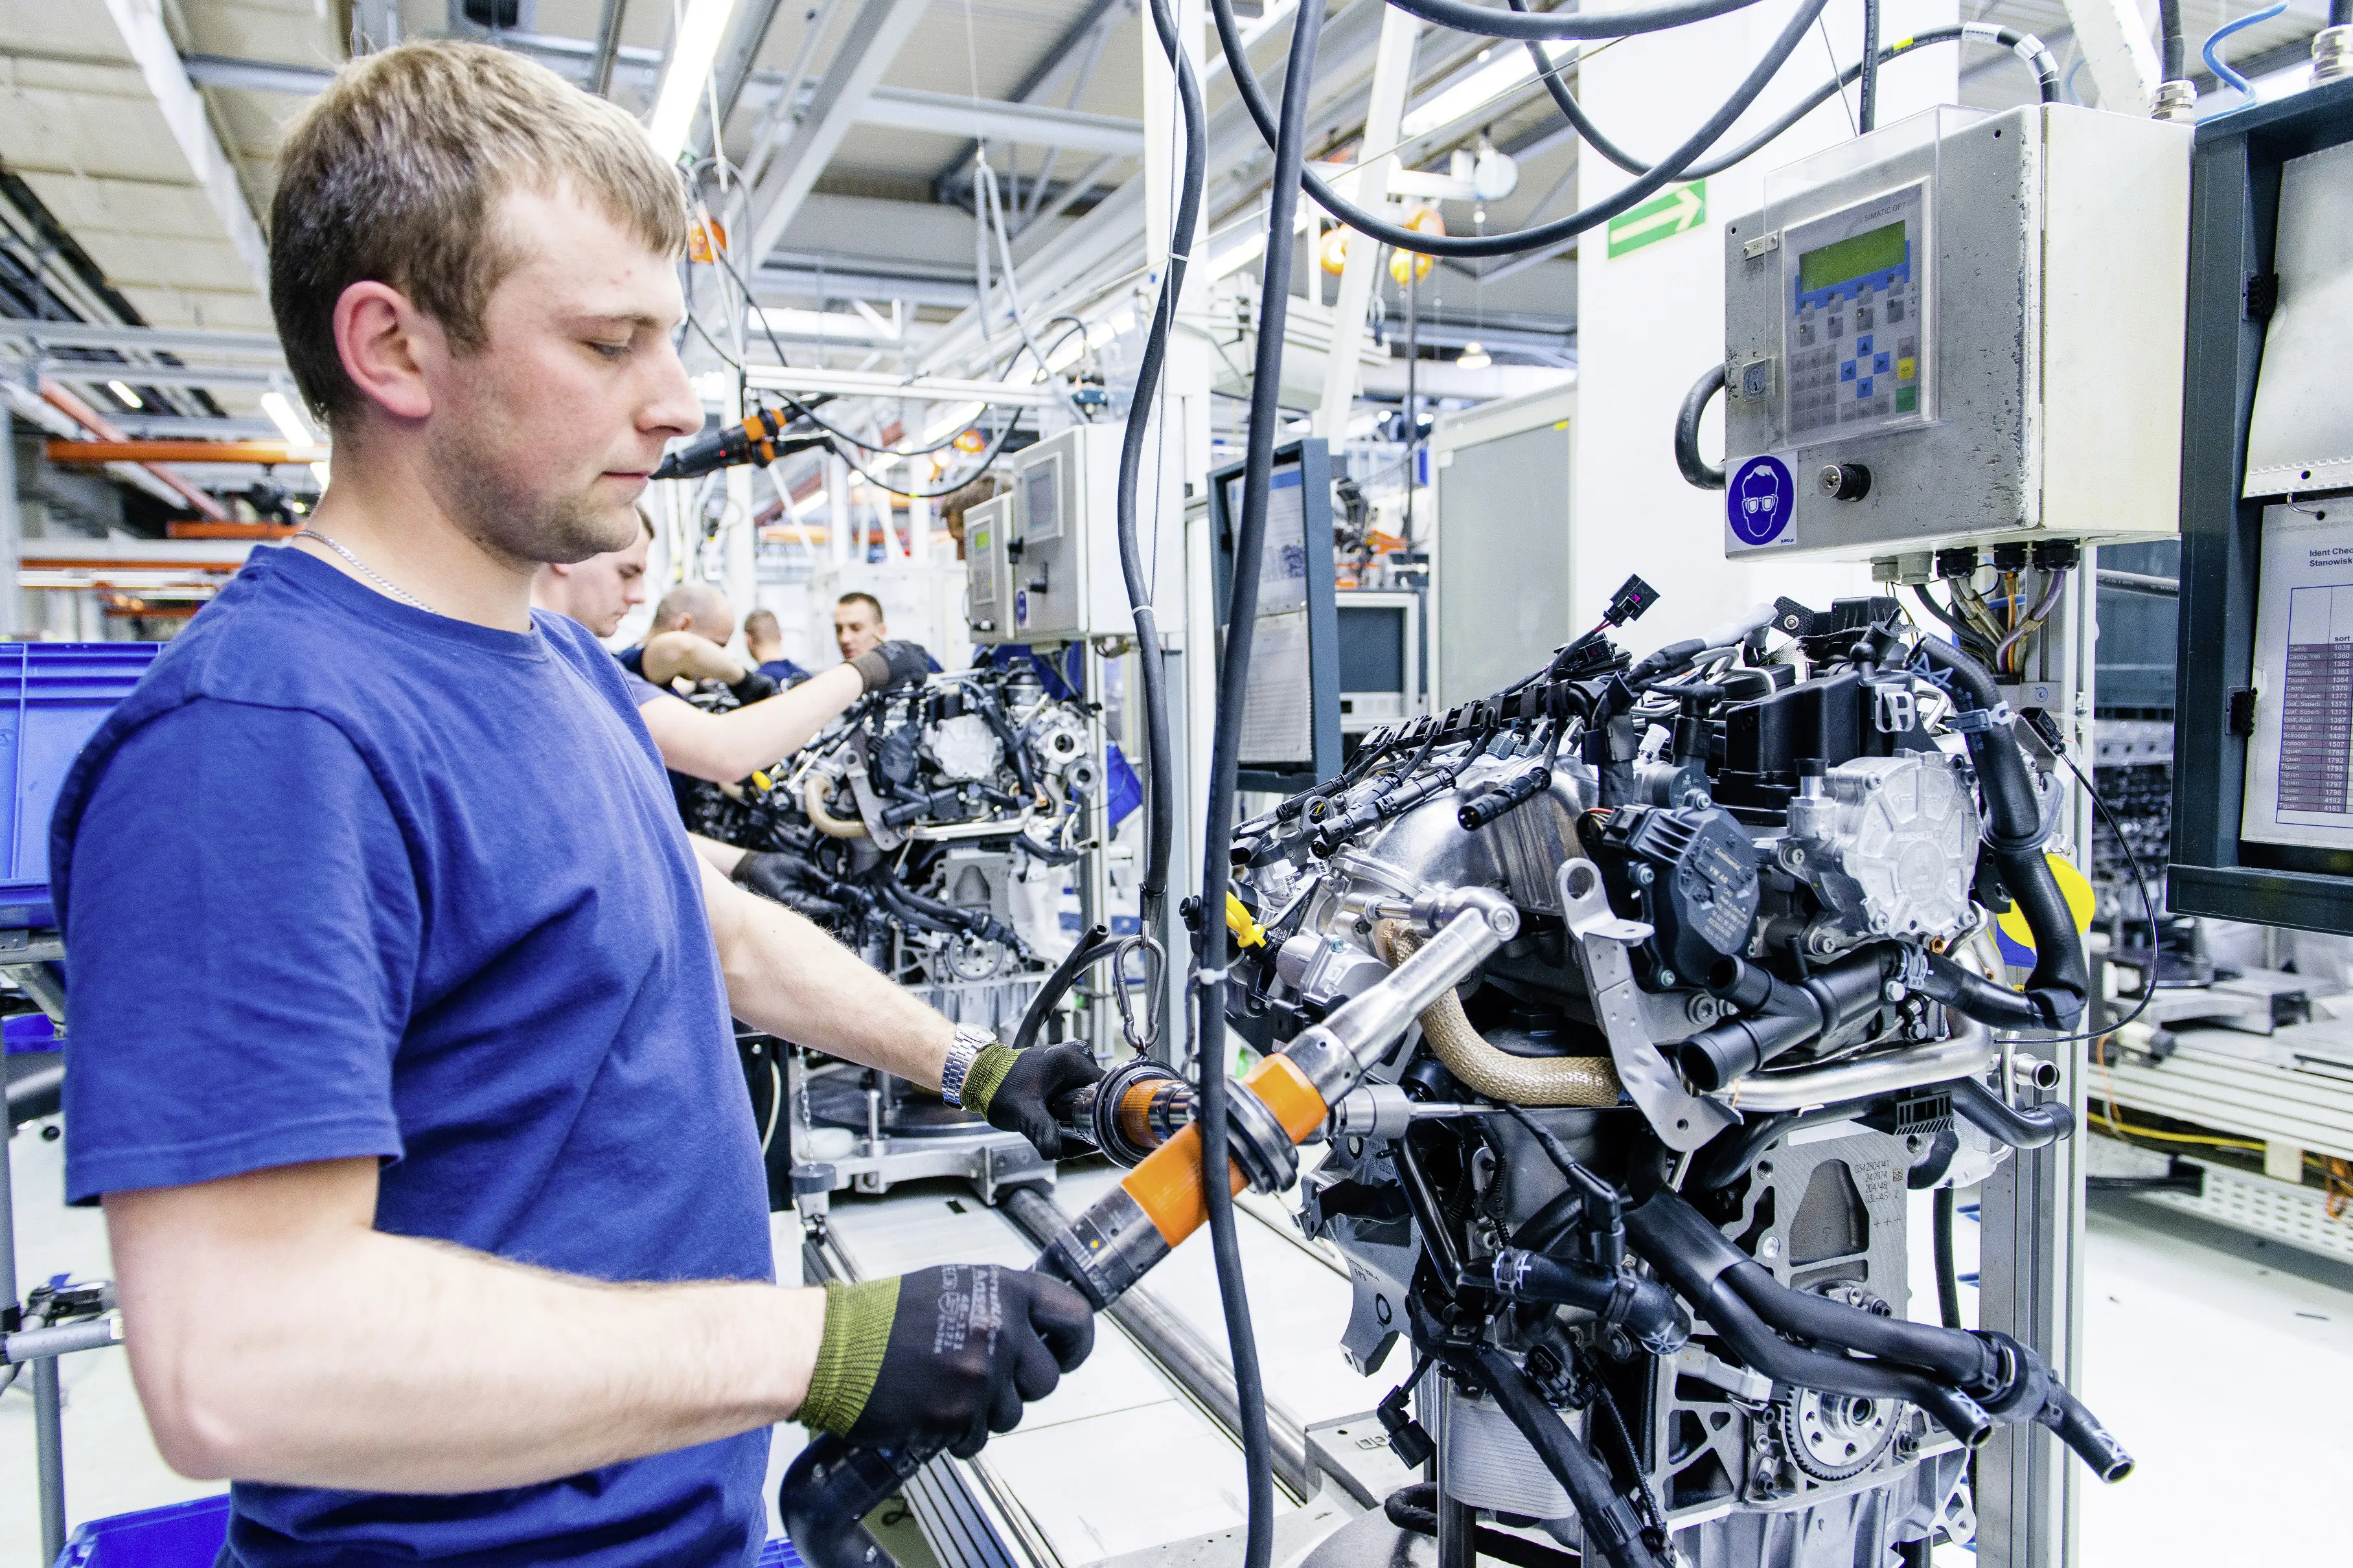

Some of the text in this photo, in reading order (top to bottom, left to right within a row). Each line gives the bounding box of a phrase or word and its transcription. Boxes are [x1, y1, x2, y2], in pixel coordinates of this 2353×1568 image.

[1865, 201, 1905, 221] SIMATIC OP7
[2310, 557, 2353, 567] Stanowisk
[1710, 865, 1728, 883] VW AG
